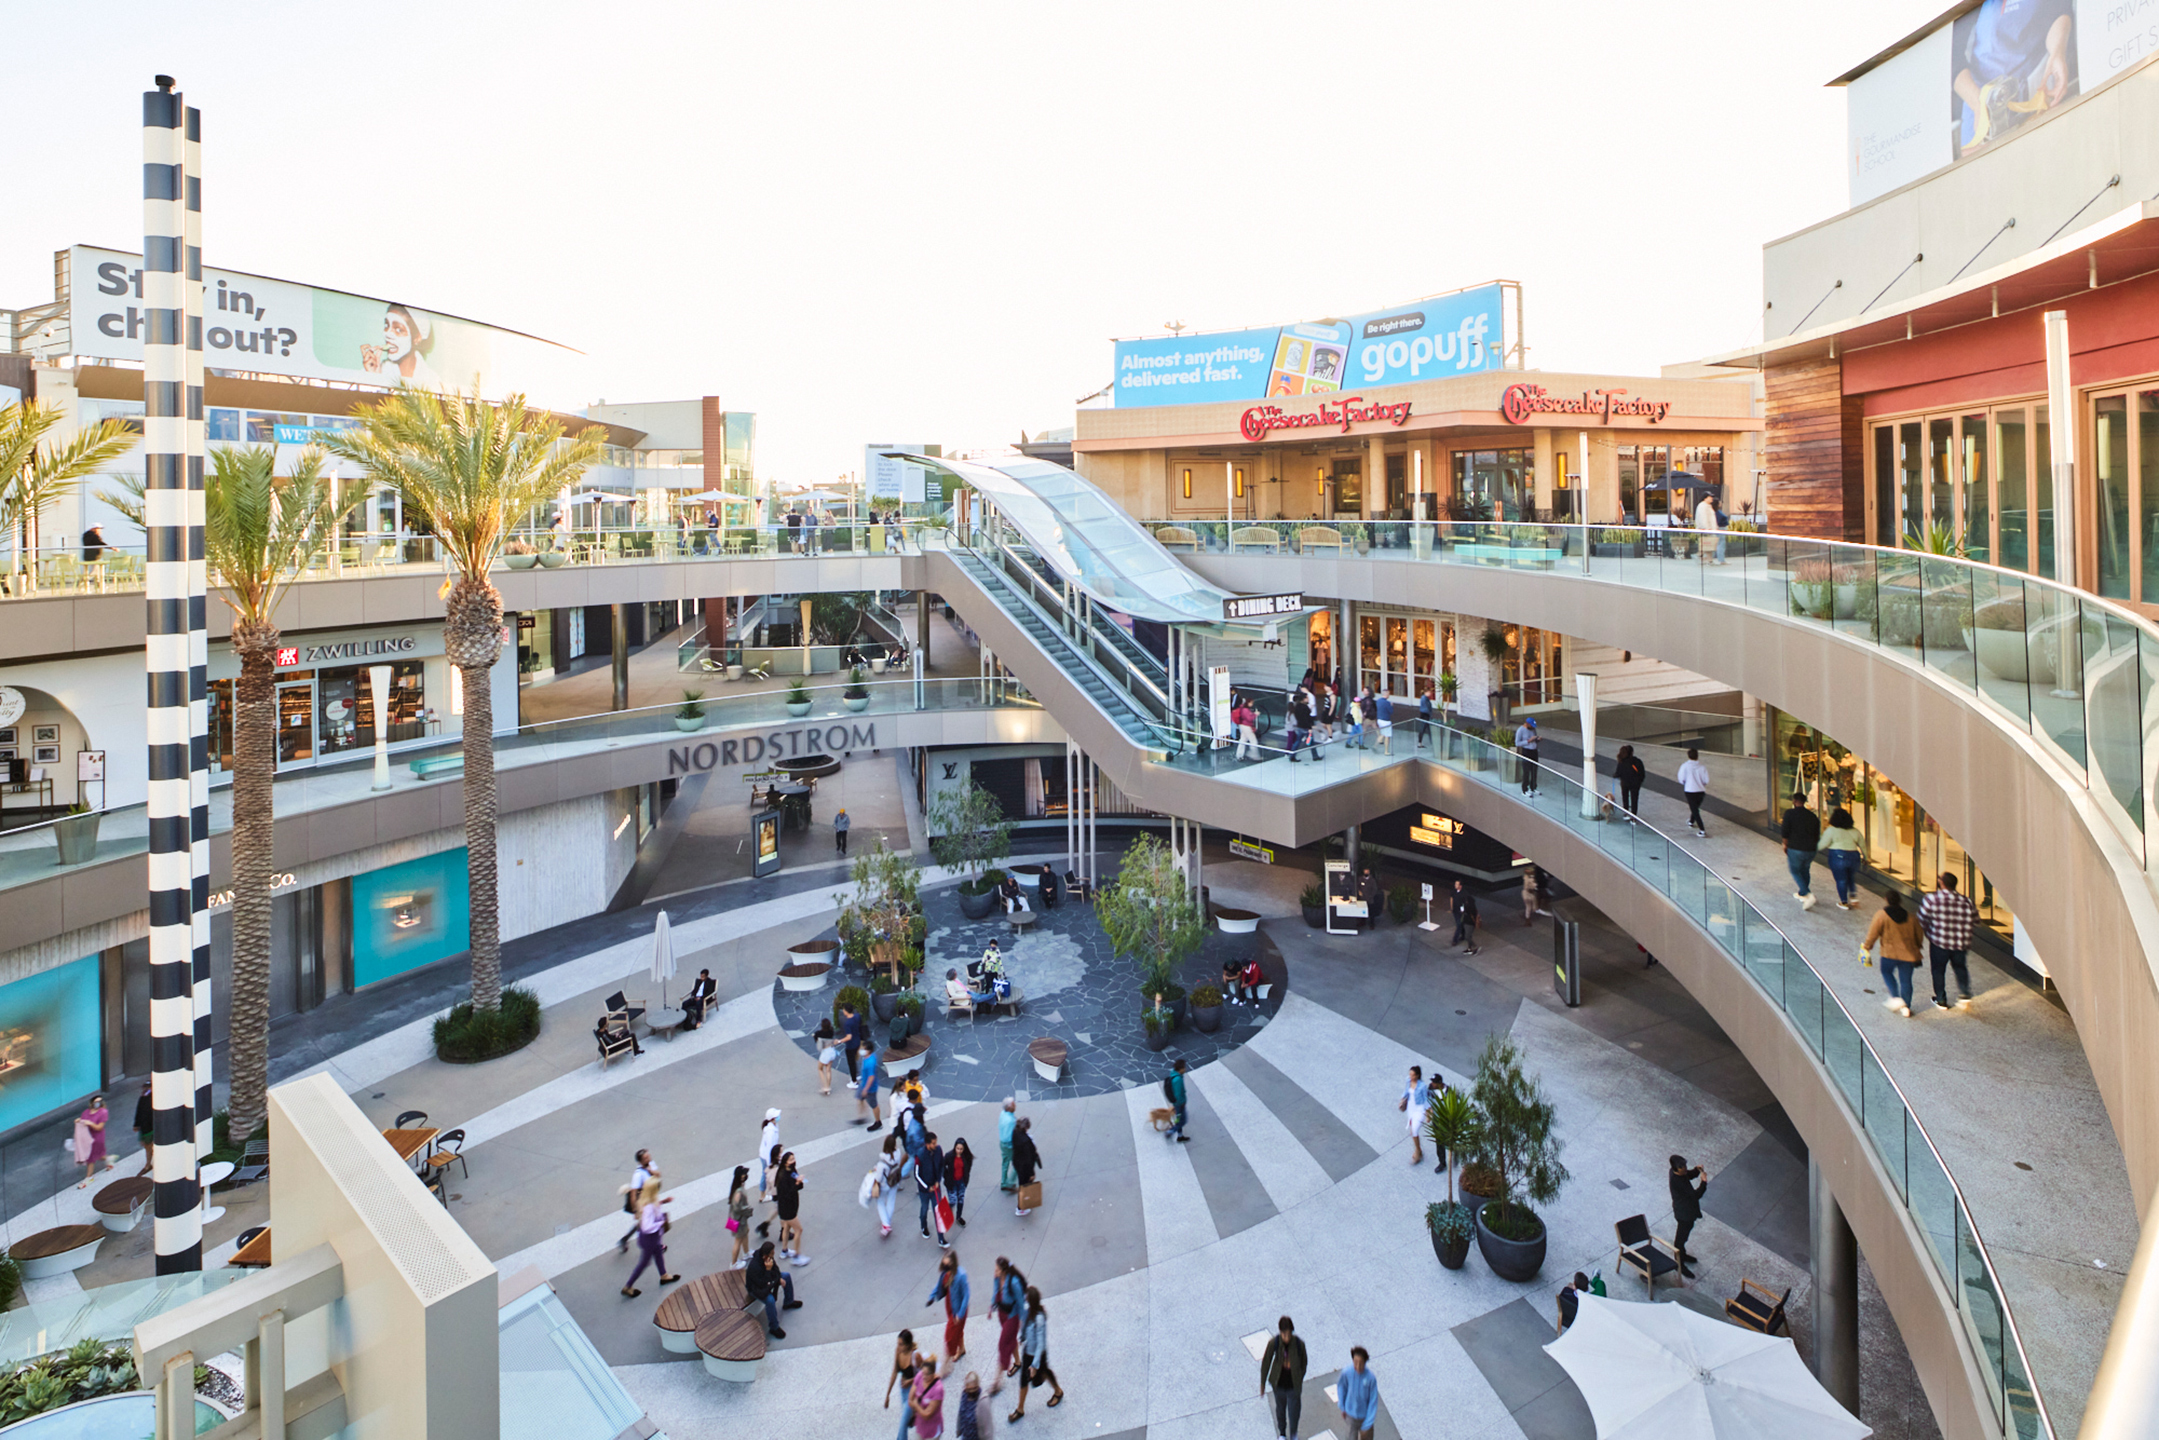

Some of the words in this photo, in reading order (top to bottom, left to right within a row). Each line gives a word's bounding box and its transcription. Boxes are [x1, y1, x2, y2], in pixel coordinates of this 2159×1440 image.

[2107, 0, 2156, 31] PRIVA
[2108, 33, 2142, 69] GIFT
[1863, 131, 1877, 145] THE
[1863, 122, 1922, 159] GOURMANDISE
[1864, 150, 1896, 172] SCHOOL
[217, 279, 266, 322] in,
[1367, 324, 1378, 334] Be
[1379, 322, 1399, 333] right
[1399, 317, 1423, 329] there.
[206, 326, 298, 357] out?
[1361, 313, 1489, 382] gopuff
[1121, 352, 1182, 371] Almost
[1184, 345, 1265, 367] anything,
[1121, 367, 1201, 388] delivered
[1203, 365, 1243, 382] fast.
[1529, 384, 1547, 396] The
[1263, 405, 1283, 417] The
[1502, 383, 1606, 425] Cheesecake
[1595, 388, 1672, 425] Factory
[1240, 406, 1341, 441] Cheesecake
[1331, 397, 1412, 433] Factory
[1237, 597, 1274, 616] DINING
[1275, 595, 1302, 612] DECK
[307, 637, 416, 663] ZWILLING
[668, 722, 877, 775] NORDSTROM
